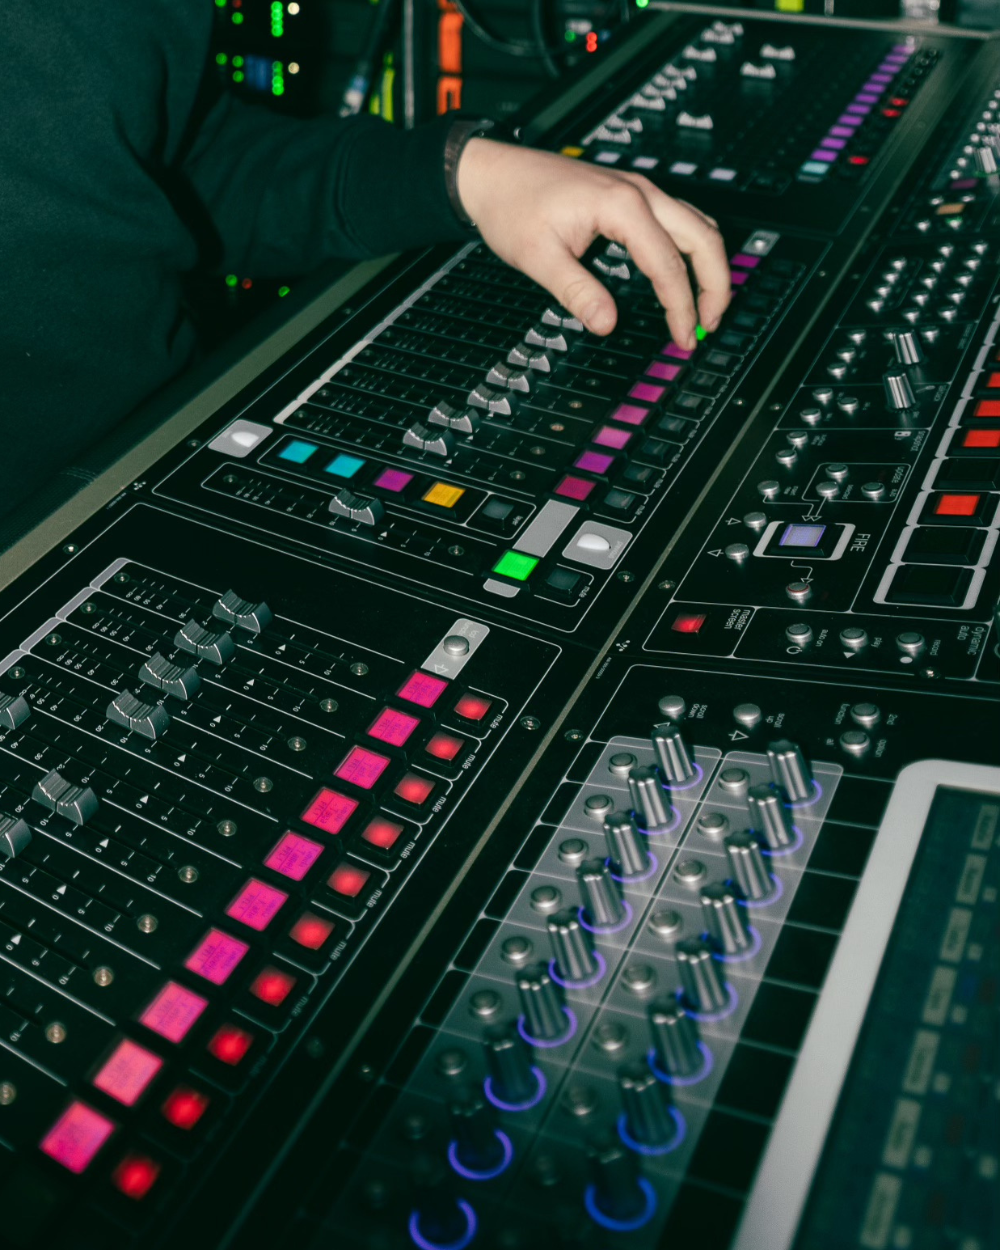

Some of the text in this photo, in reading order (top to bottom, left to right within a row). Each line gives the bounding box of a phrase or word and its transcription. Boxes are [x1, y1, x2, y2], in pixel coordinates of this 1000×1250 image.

[910, 430, 926, 451] snapshot
[891, 466, 905, 483] update
[634, 505, 646, 516] mute
[512, 515, 523, 526] layer
[850, 533, 871, 552] FIRE
[578, 585, 590, 598] mute
[724, 608, 741, 629] screen
[734, 609, 751, 631] master
[815, 629, 829, 647] auto on
[957, 625, 970, 640] auto
[967, 626, 986, 655] dynamic
[870, 637, 882, 648] play
[929, 639, 941, 656] record
[688, 703, 700, 718] down
[696, 704, 708, 719] scroll
[765, 715, 774, 723] up
[835, 703, 850, 725] function
[886, 713, 898, 725] 2nd
[489, 714, 503, 729] mute
[773, 713, 785, 728] scroll
[875, 739, 887, 757] option
[461, 754, 476, 769] mute
[432, 796, 447, 813] mute
[400, 841, 416, 859] mute
[366, 889, 382, 908] mute
[330, 941, 347, 961] mute
